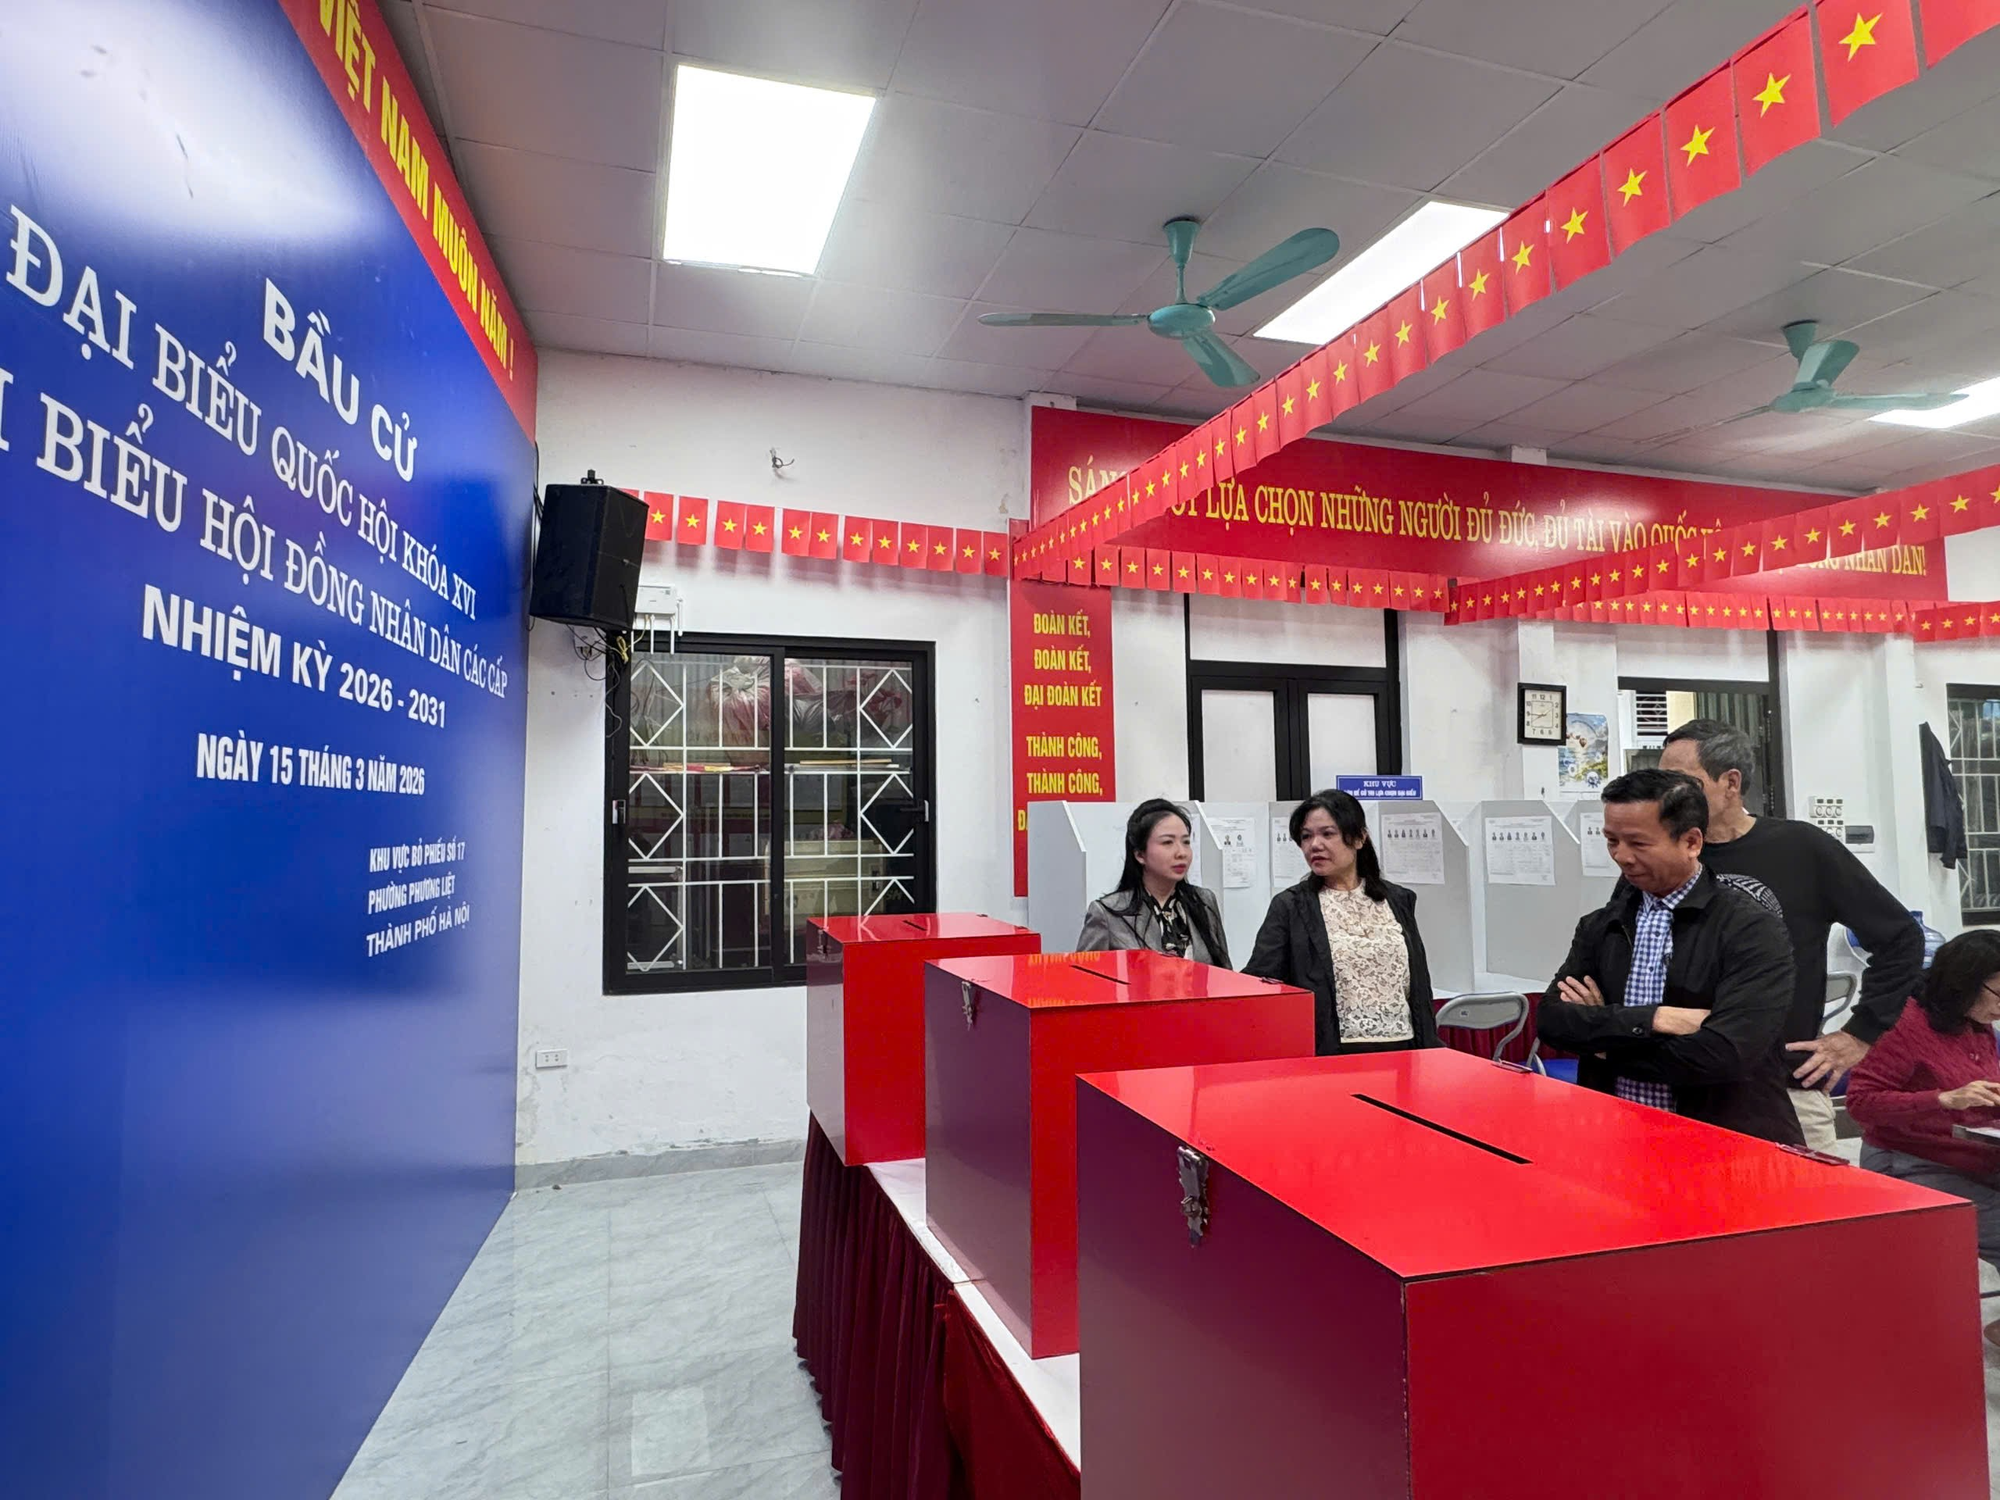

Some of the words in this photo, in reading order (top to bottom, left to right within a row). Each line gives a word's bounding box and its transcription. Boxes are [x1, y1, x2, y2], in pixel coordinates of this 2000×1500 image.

[381, 75, 429, 221] NAM
[433, 181, 478, 315] MUÔN
[480, 277, 508, 370] NĂM
[509, 337, 514, 381] !
[263, 277, 360, 425] BẦU
[371, 403, 418, 482] CỬ
[5, 204, 137, 370] ĐẠI
[152, 323, 262, 456] BIỂU
[271, 426, 354, 527] QUỐC
[358, 493, 398, 564] HỘI
[402, 530, 449, 600] KHÓA
[451, 572, 477, 621] XVI
[1069, 454, 1127, 505] SÁ
[1206, 477, 1249, 531] LỰA
[1254, 484, 1314, 536] CHỌN
[1320, 485, 1394, 534] NHỮNG
[1399, 492, 1461, 541] NGƯỜI
[1466, 491, 1492, 543] ĐỦ
[1498, 500, 1539, 552] ĐỨC,
[1543, 499, 1569, 550] ĐỦ
[1574, 508, 1605, 552] TÀI
[1609, 510, 1646, 553] VÀO
[36, 392, 188, 532] BIỂU
[200, 487, 276, 586] HỘI
[284, 530, 365, 627] ĐỒNG
[369, 590, 427, 658] NHÂN
[429, 623, 462, 676] DÂN
[463, 643, 487, 690] CÁC
[487, 655, 508, 699] CẤP
[1033, 610, 1065, 635] ĐOÀN
[1068, 608, 1091, 638] KẾT,
[142, 583, 281, 681] NHIỆM
[292, 639, 333, 692] KỲ
[339, 661, 393, 712] 2026
[397, 698, 405, 707] -
[408, 688, 446, 728] 2031
[1034, 645, 1066, 671] ĐOÀN
[1069, 644, 1091, 674] KẾT,
[1024, 684, 1044, 710] ĐẠI
[1047, 681, 1079, 707] ĐOÀN
[1081, 679, 1102, 707] KẾT
[196, 730, 263, 783] NGÀY
[269, 744, 293, 785] 15
[299, 744, 352, 790] THÁNG
[355, 765, 365, 790] 3
[367, 756, 396, 793] NĂM
[399, 764, 425, 796] 2026
[1026, 731, 1064, 758] THÀNH
[1068, 732, 1102, 760] CÔNG,
[1027, 767, 1065, 794] THÀNH
[1068, 769, 1103, 796] CÔNG,
[369, 847, 390, 872] KHU
[392, 844, 410, 874] VỰC
[411, 837, 423, 867] BỎ
[424, 837, 446, 865] PHIẾU
[447, 835, 457, 862] SỐ
[457, 841, 466, 860] 17
[368, 880, 408, 915] PHƯỜNG
[408, 877, 440, 905] PHƯƠNG
[441, 870, 456, 900] LIỆT
[366, 922, 412, 957] THÀNH
[414, 905, 438, 941] PHỐ
[439, 905, 452, 932] HÀ
[454, 901, 470, 929] NỘI
